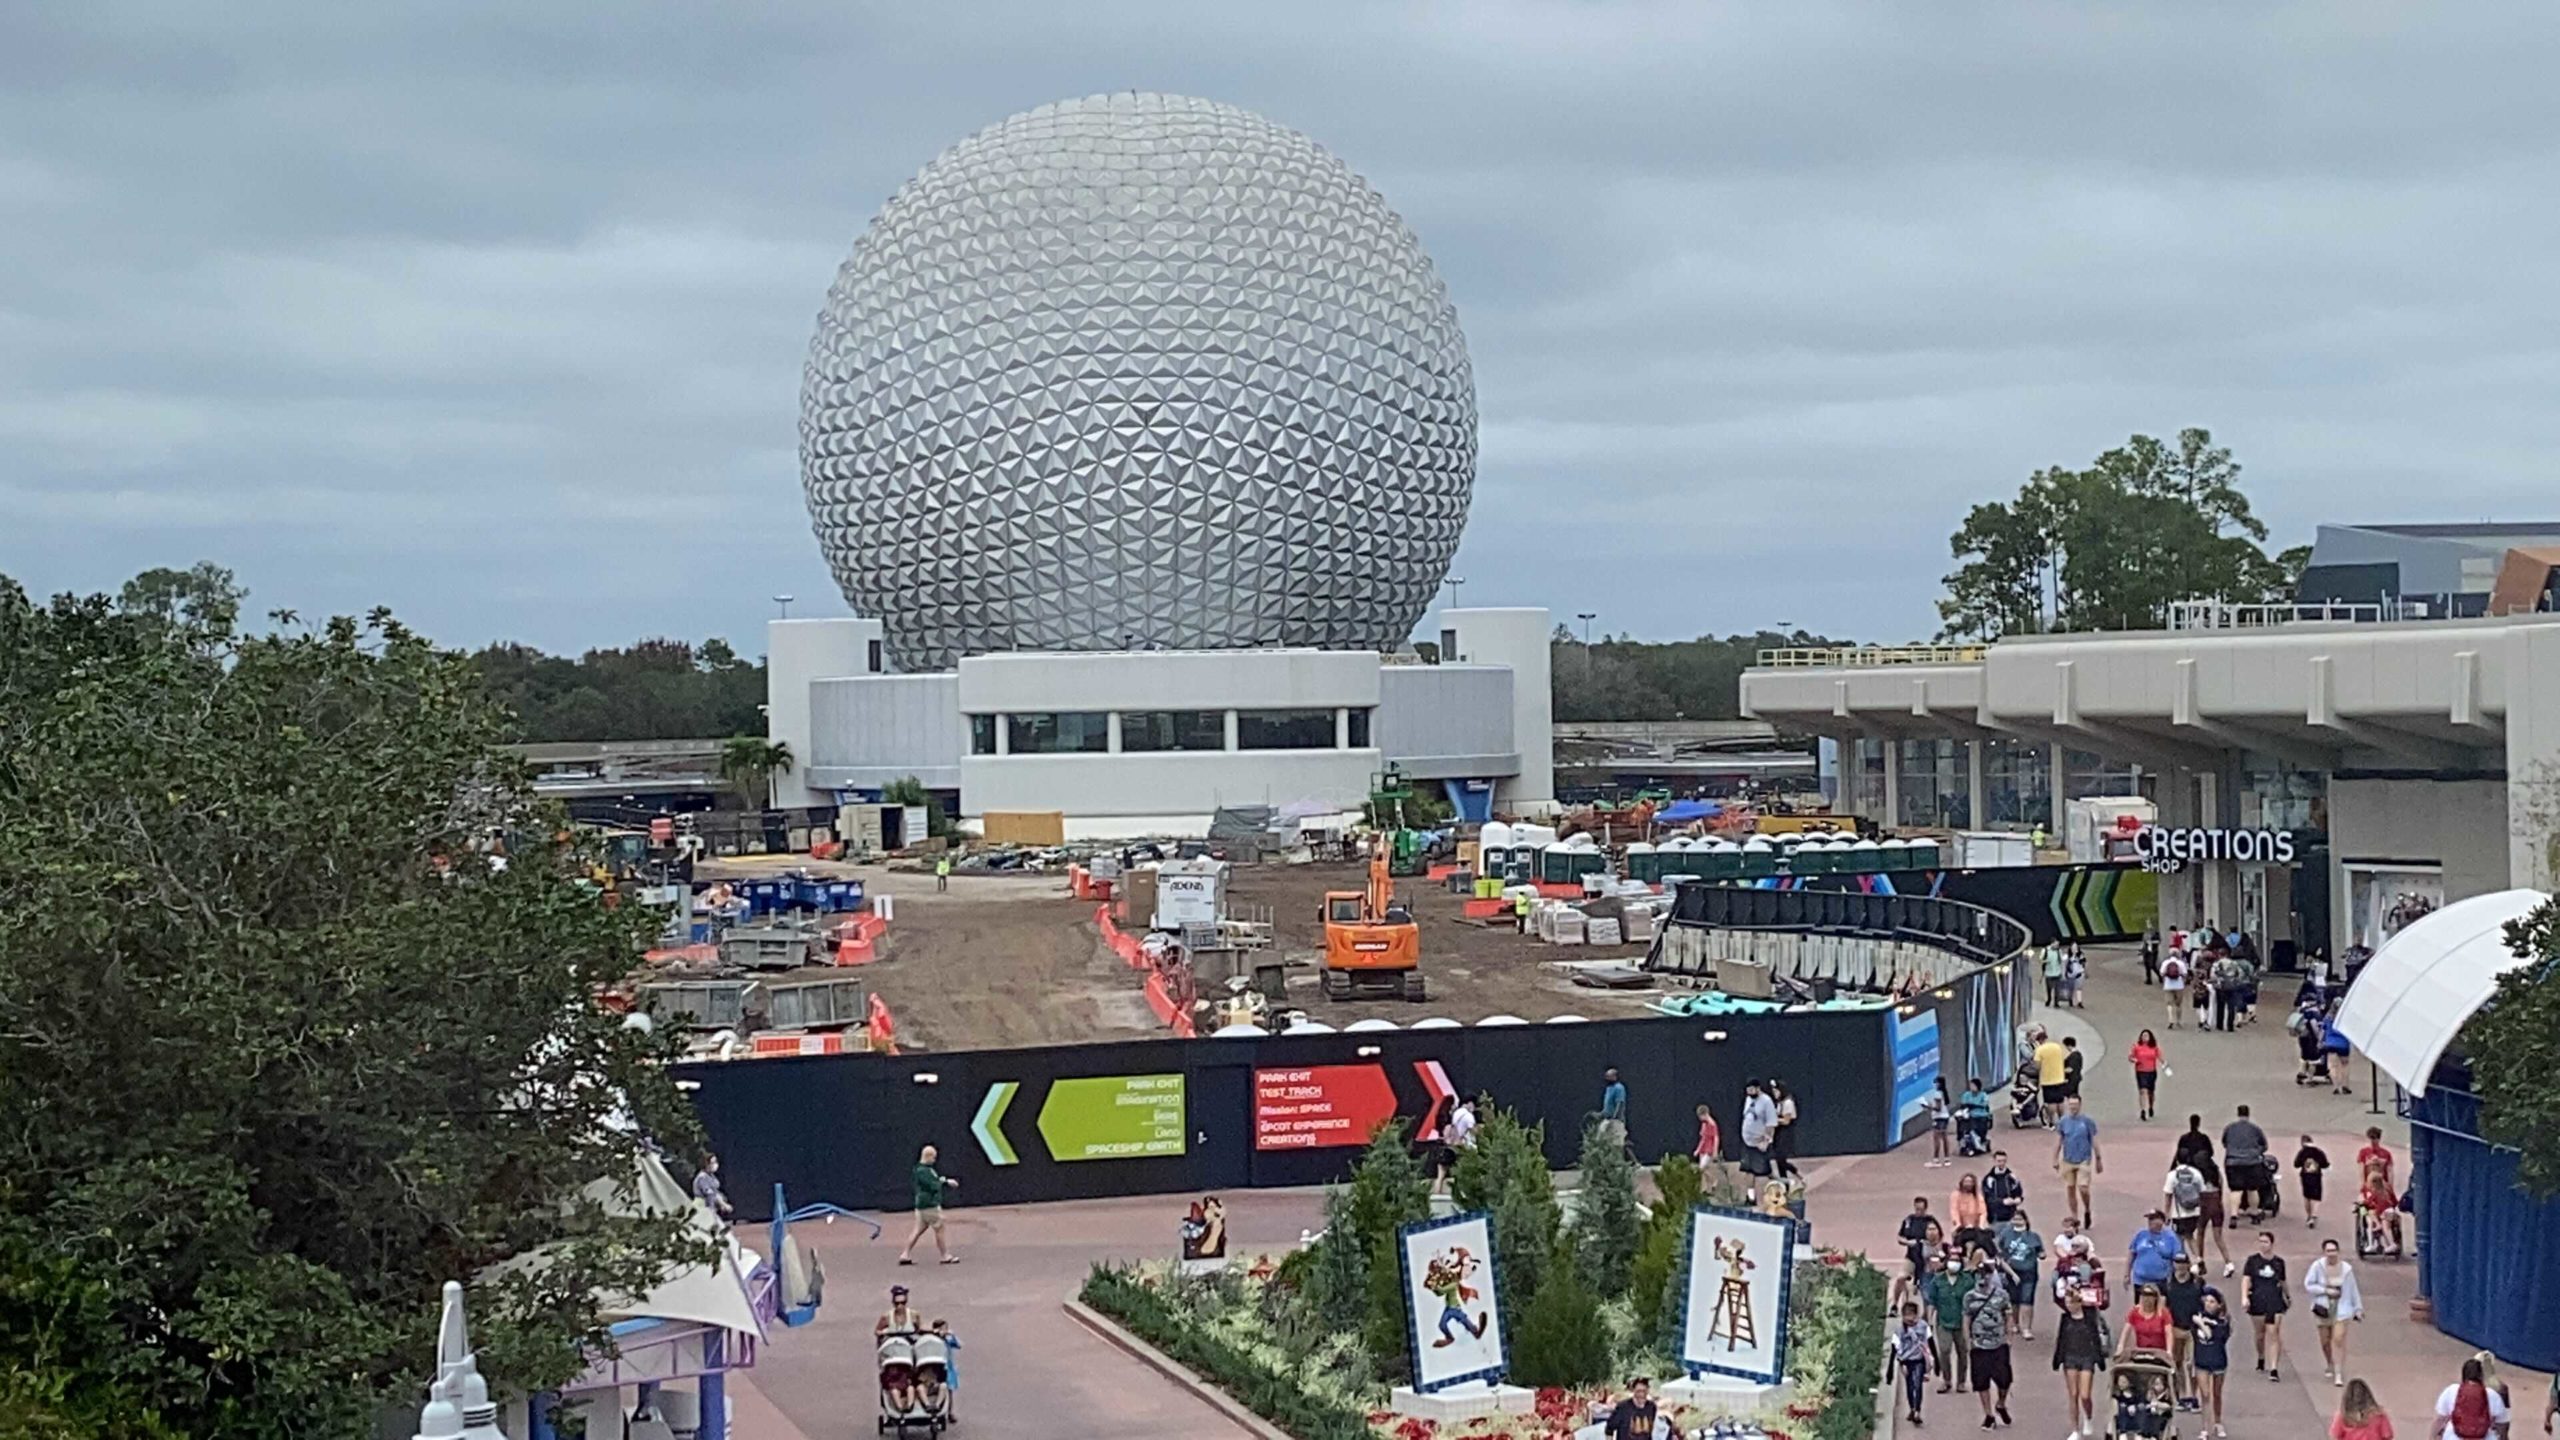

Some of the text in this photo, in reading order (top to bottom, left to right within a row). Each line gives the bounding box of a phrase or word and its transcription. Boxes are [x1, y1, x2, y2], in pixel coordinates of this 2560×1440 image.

[2133, 828, 2294, 862] CREATIONS
[2141, 859, 2180, 873] SHOP
[1259, 1071, 1312, 1083] PARK EXIT
[1126, 1078, 1180, 1090] PARK EXIT
[1260, 1086, 1323, 1099] TEST TRACK
[1300, 1103, 1332, 1113] SPACE
[1260, 1119, 1350, 1132] EPCOT EXPERIENCE
[1260, 1134, 1316, 1145] CREATIONS
[1085, 1140, 1181, 1155] SPACESHIP EARTH
